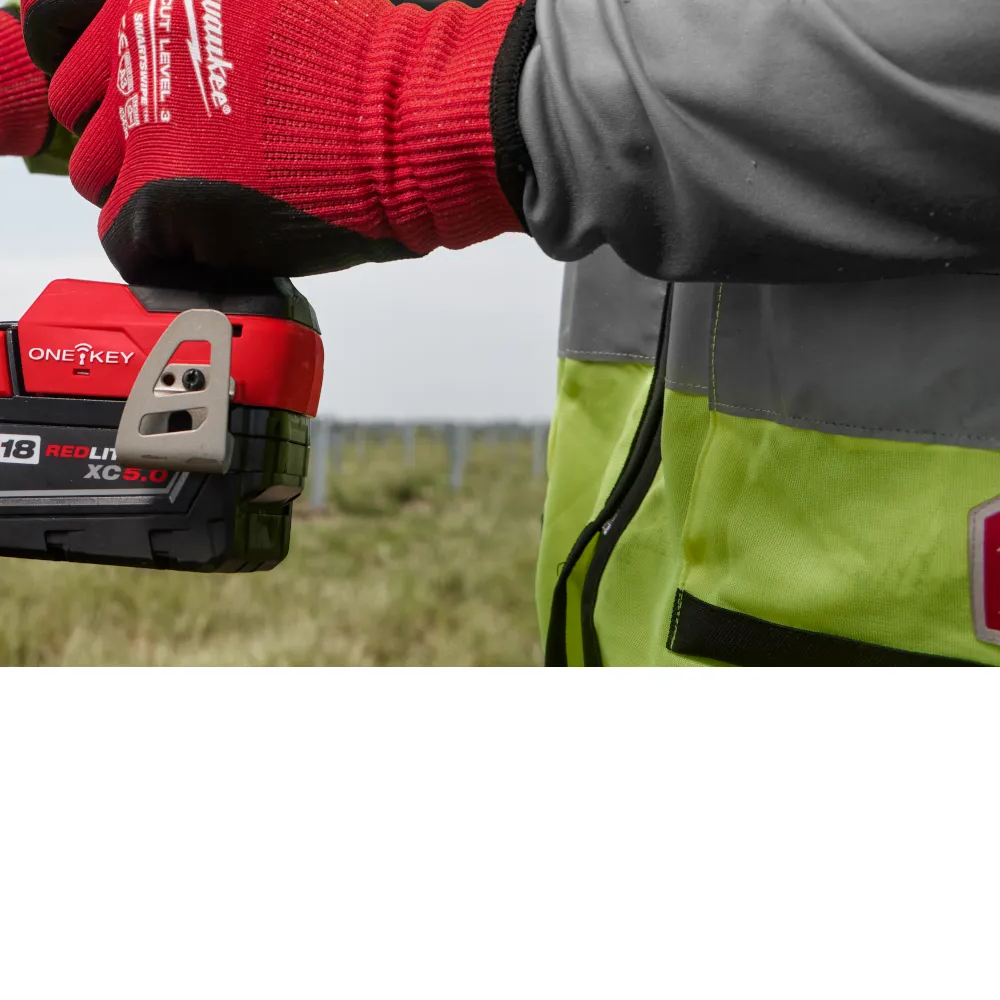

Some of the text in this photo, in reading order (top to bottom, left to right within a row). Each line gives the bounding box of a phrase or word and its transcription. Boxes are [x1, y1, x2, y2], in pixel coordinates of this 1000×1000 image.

[159, 38, 171, 102] LEVEL
[160, 110, 171, 123] 3
[28, 347, 135, 364] ONE KEY
